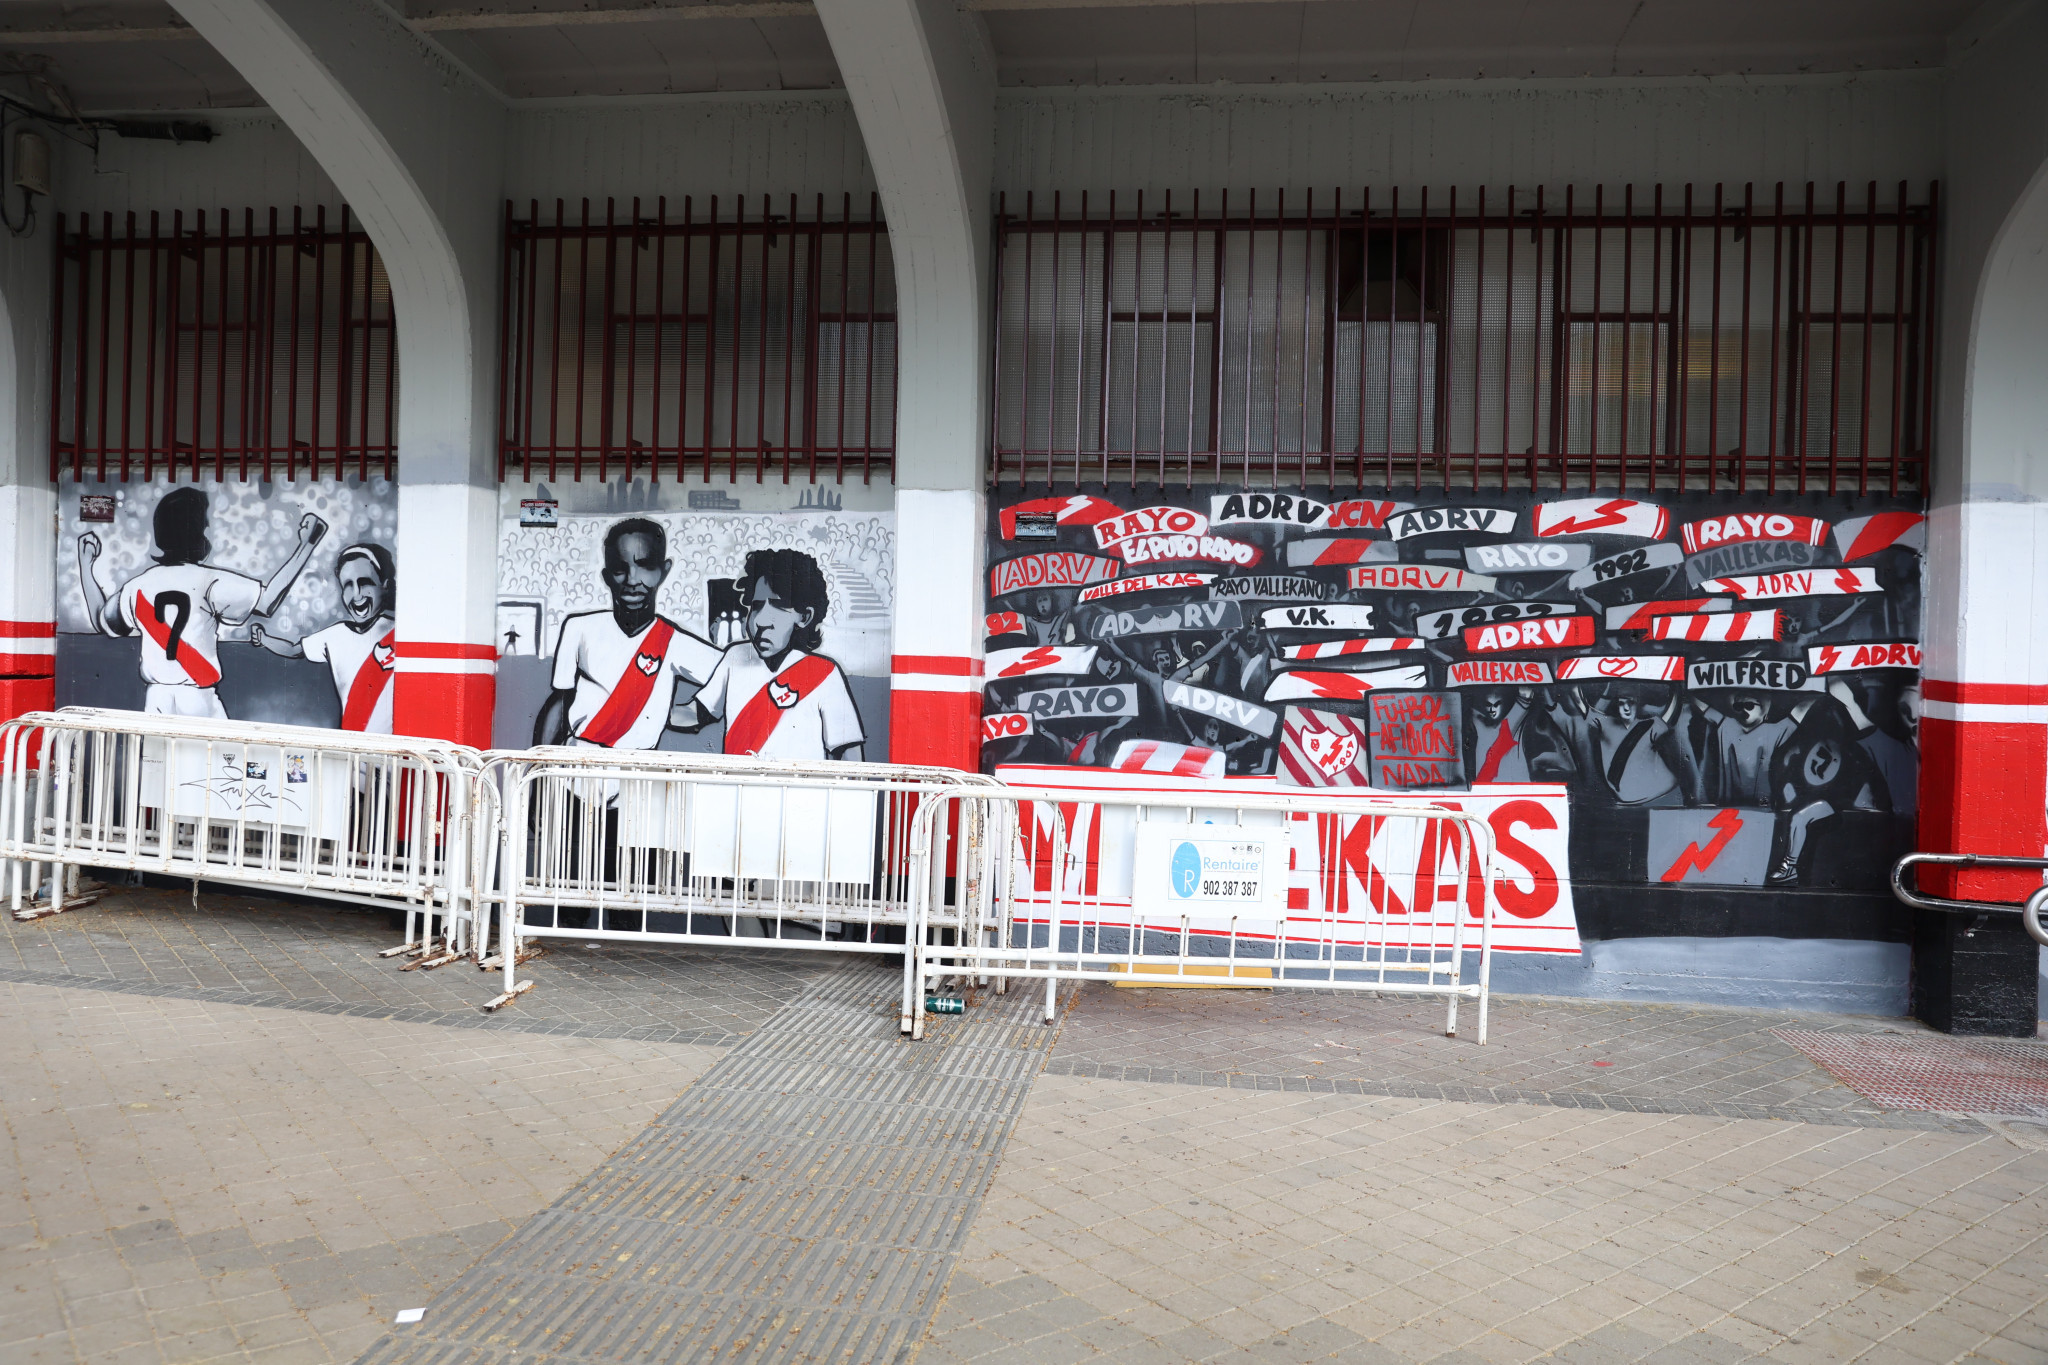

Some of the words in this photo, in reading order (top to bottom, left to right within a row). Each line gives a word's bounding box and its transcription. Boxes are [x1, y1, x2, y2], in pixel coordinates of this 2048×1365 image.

[1220, 494, 1325, 523] ADRV
[1400, 508, 1497, 537] ADRV
[1097, 508, 1196, 545] RAYO
[1700, 514, 1794, 545] RAYO
[1120, 537, 1150, 565] EL
[1148, 535, 1199, 560] PUTO
[1200, 536, 1254, 564] RAYO
[1476, 544, 1568, 568] RAYO
[1693, 541, 1810, 580] VALLEKAS
[1003, 551, 1096, 590] ADRV
[1593, 548, 1650, 582] 1992
[1084, 582, 1120, 601] VALLE
[1122, 576, 1153, 593] DEL
[1157, 572, 1204, 587] KAS
[1215, 577, 1249, 598] RAYO
[1253, 577, 1325, 600] VALLEKANO
[1756, 571, 1812, 596] ADRV
[154, 590, 191, 661] 7
[1286, 607, 1335, 627] V.K.
[1477, 619, 1570, 650] ADRV
[1851, 643, 1921, 668] ADRV
[1450, 661, 1544, 683] VALLEKAS
[1694, 660, 1807, 689] WILFRED
[1027, 687, 1126, 718] RAYO
[1171, 685, 1260, 727] ADRV
[1382, 762, 1449, 788] NADA
[1203, 856, 1259, 871] Rentaire
[1183, 869, 1196, 893] R
[1203, 880, 1220, 896] 902
[1222, 880, 1239, 896] 387
[1241, 881, 1258, 897] 387
